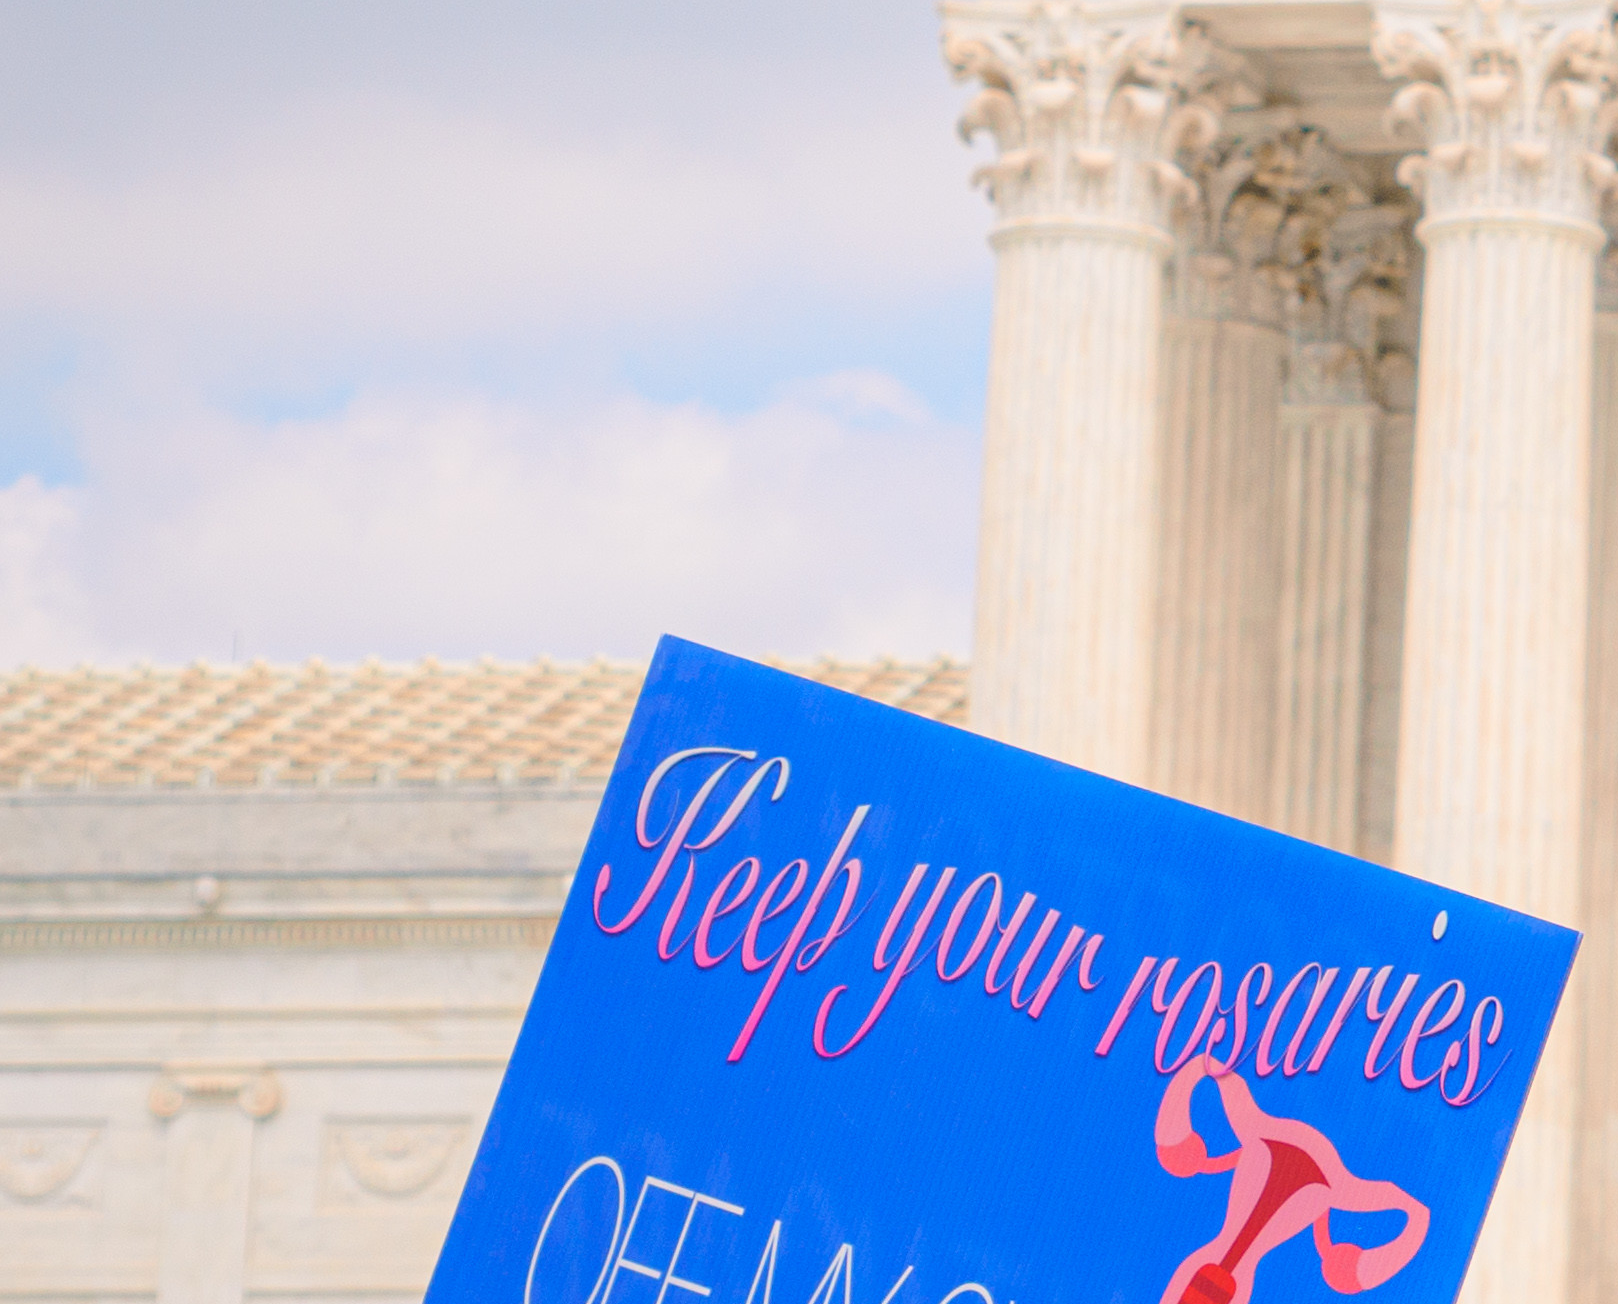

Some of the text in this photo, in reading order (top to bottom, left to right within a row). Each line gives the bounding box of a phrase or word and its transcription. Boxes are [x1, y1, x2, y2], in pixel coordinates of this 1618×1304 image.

[592, 746, 1514, 1107] Keep your rosaries
